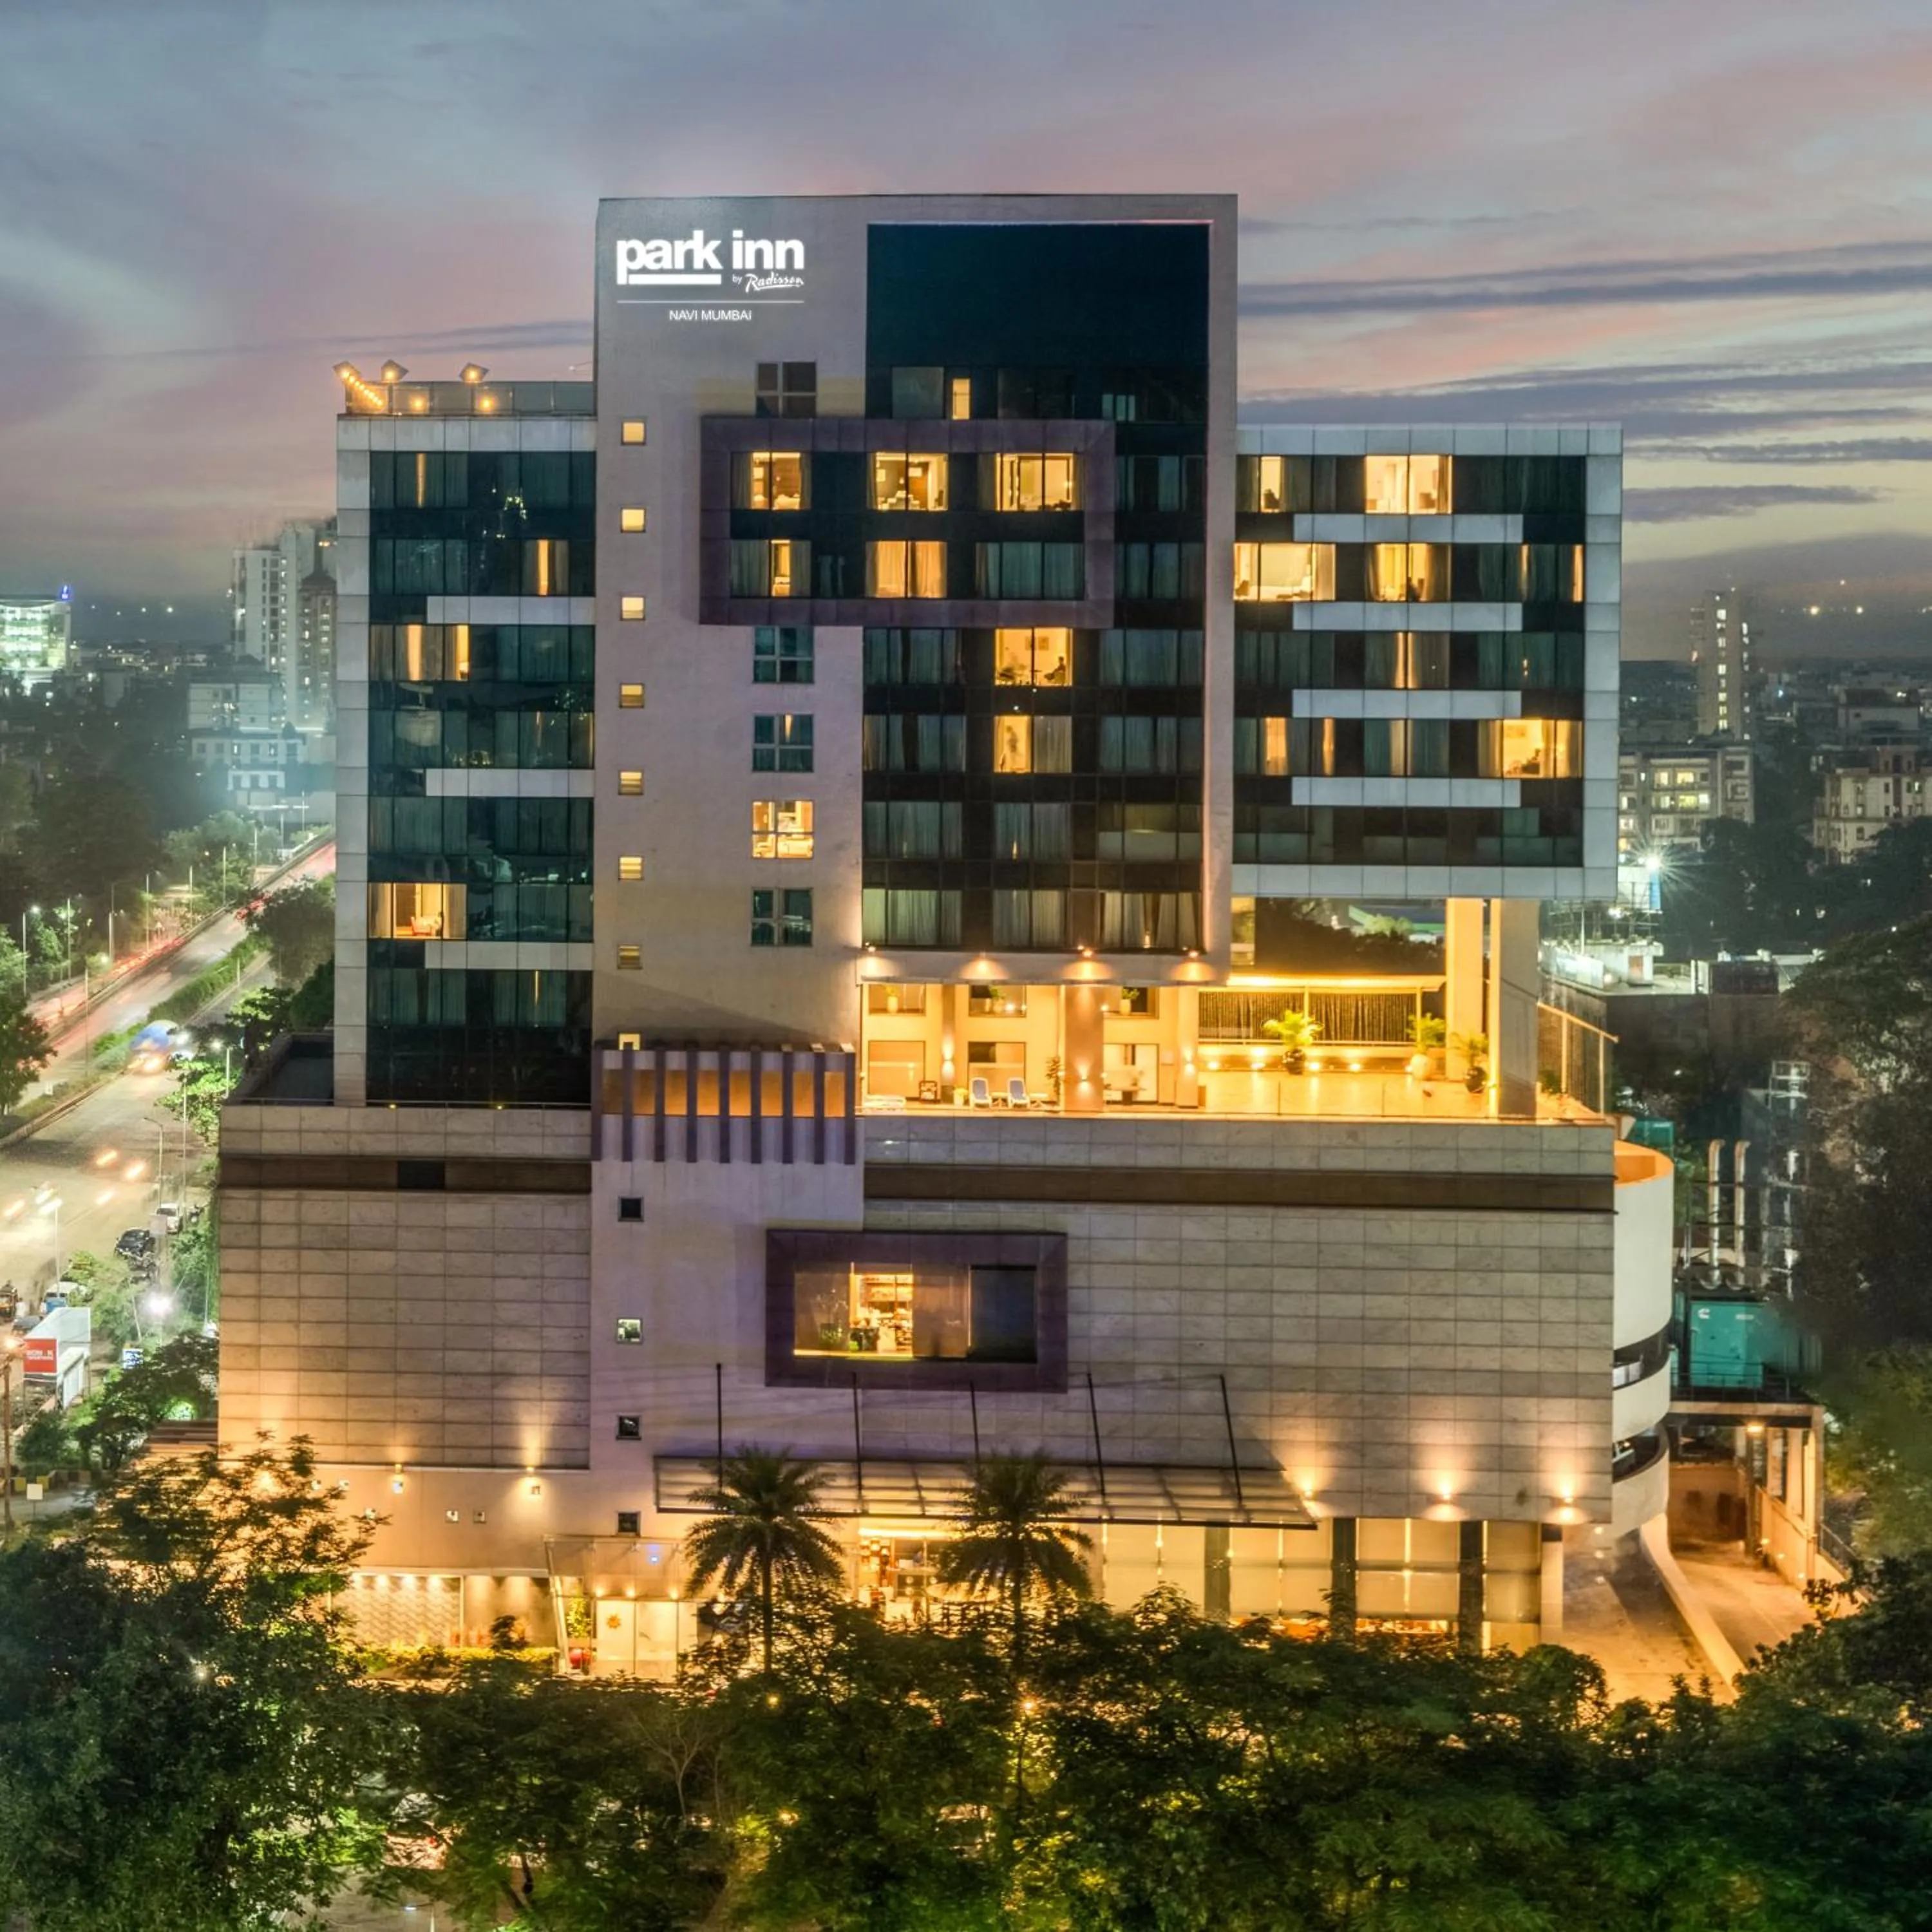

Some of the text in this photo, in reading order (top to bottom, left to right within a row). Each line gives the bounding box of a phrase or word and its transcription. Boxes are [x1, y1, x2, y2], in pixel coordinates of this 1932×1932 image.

[616, 229, 804, 285] park inn
[732, 271, 804, 293] by Radisson
[669, 310, 752, 321] NAVI MUMBAI
